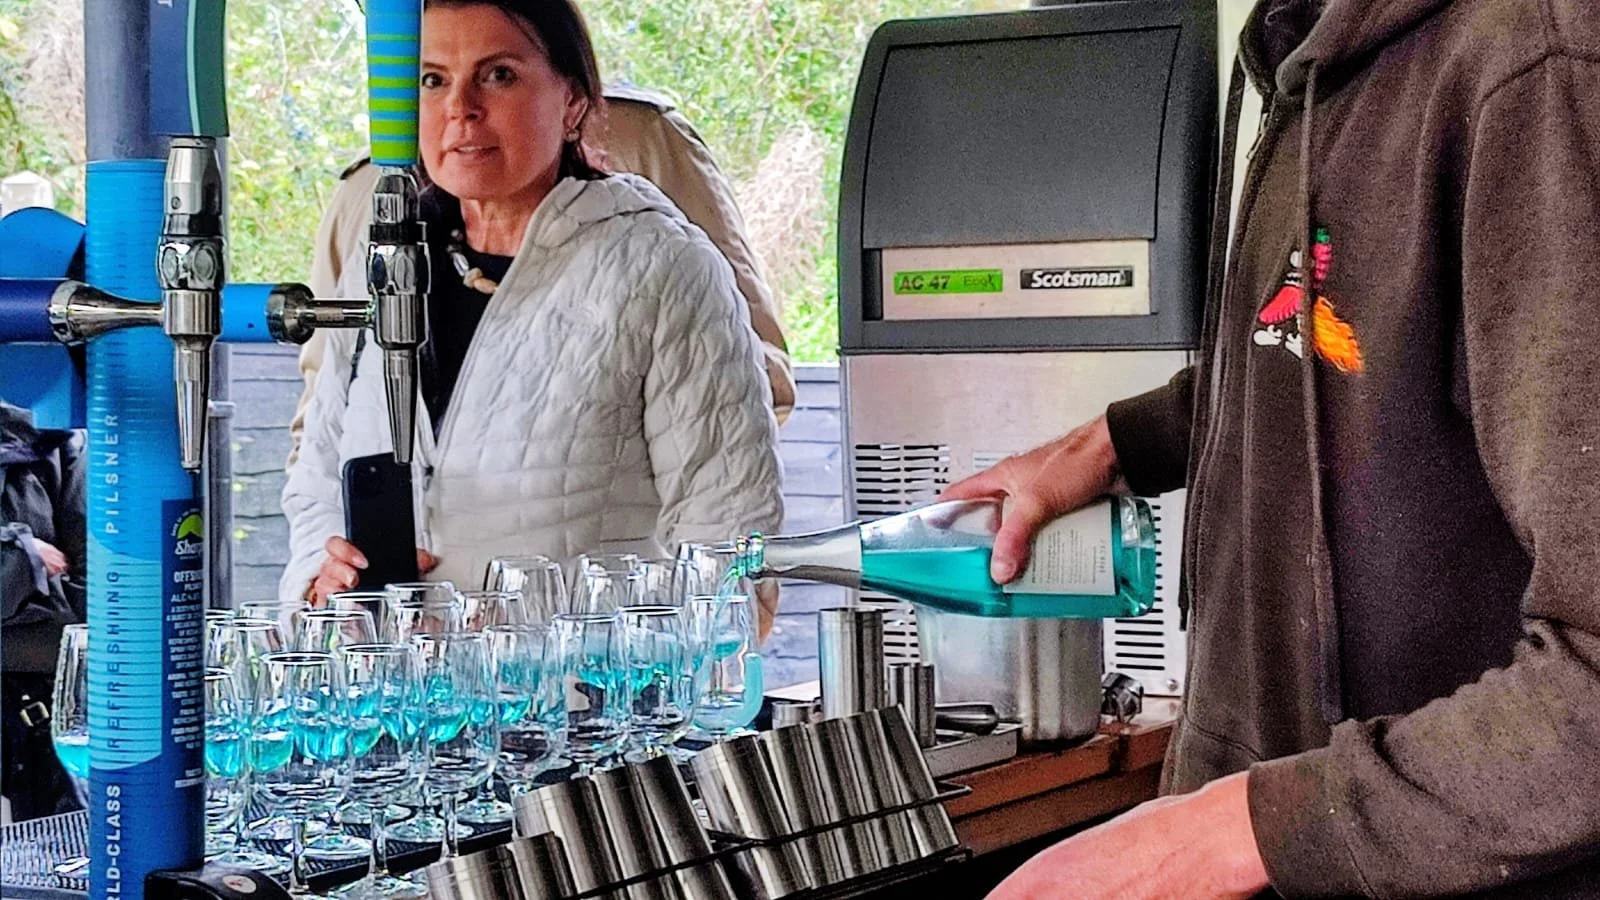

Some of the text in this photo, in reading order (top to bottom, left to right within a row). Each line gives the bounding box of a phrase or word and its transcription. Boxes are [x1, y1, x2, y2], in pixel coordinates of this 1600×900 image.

[899, 275, 924, 290] AC
[928, 275, 950, 290] 47
[1031, 270, 1121, 288] Scotsman
[106, 414, 120, 534] PILSNER
[106, 571, 120, 749] REFRESHING
